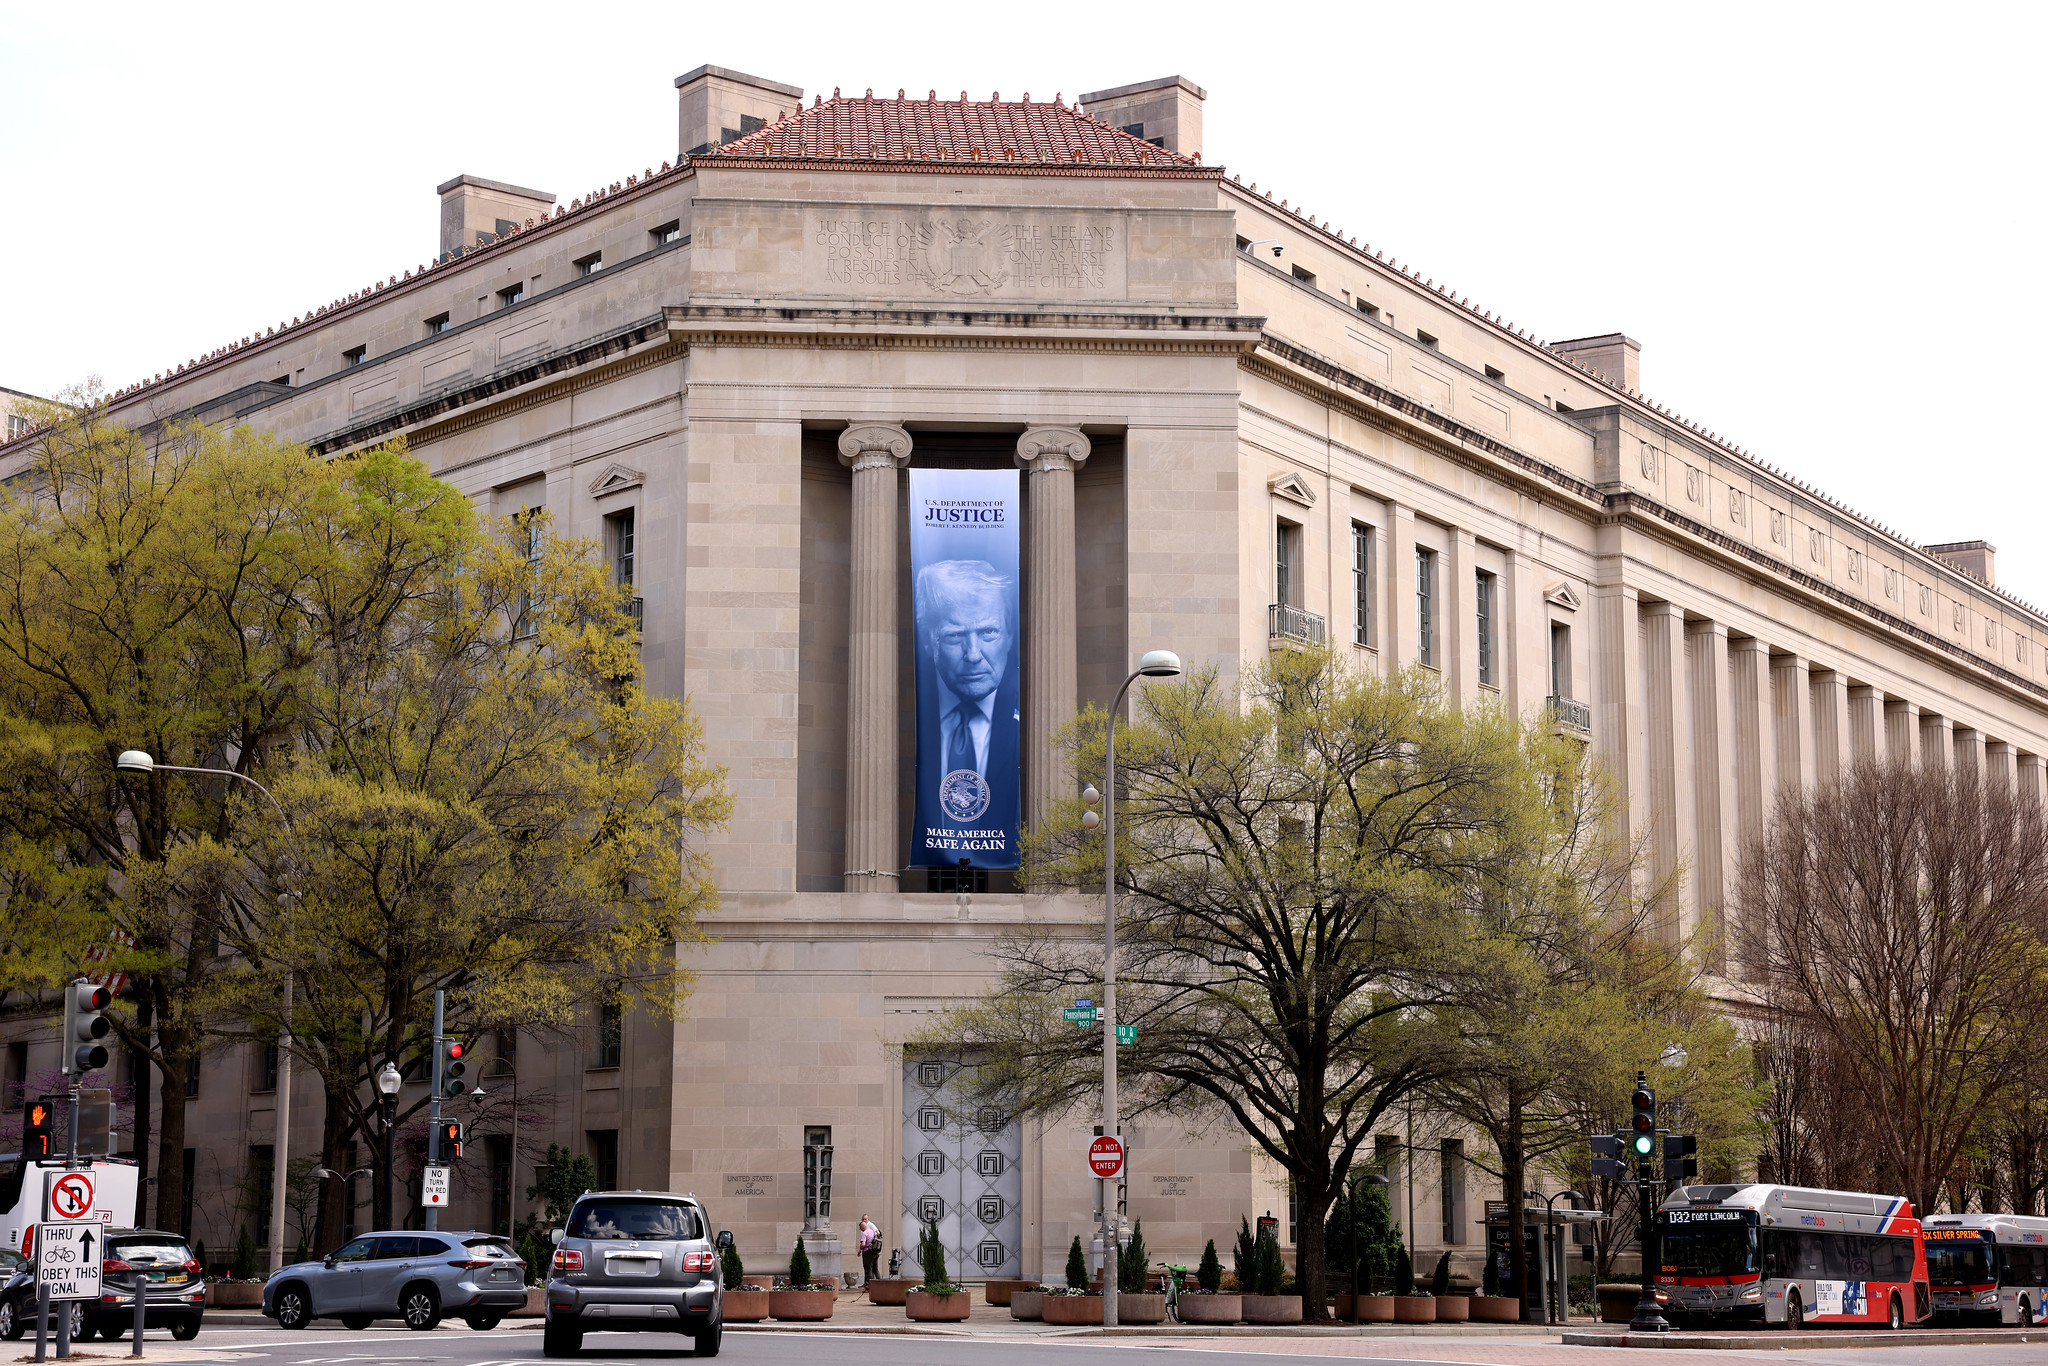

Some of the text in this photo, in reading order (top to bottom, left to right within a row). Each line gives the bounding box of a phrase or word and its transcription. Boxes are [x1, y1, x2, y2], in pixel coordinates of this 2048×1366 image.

[816, 221, 1114, 239] JUSTICE IN THE LIFE AND
[816, 233, 1113, 251] CONDUCT OF THE STATE IS
[828, 246, 1104, 264] POSSIBLE ONLY AS FIRST
[827, 259, 1105, 276] IT RESIDES IN THE HEARTS
[824, 272, 852, 284] AND
[857, 272, 901, 285] SOULS
[907, 273, 921, 286] OF
[1011, 275, 1036, 288] THE
[925, 508, 1005, 522] JUSTICE
[927, 828, 1005, 838] MAKE AMERICA
[926, 838, 1005, 850] SAFE AGAIN
[1065, 1010, 1090, 1020] Pennsylvania
[1118, 1027, 1126, 1036] 10
[40, 1135, 47, 1155] 7
[454, 1143, 459, 1156] 7
[431, 1169, 442, 1177] NO
[1669, 1212, 1740, 1223] D32 FORT LINCOLN
[1801, 1214, 1825, 1227] metrobus
[45, 1228, 74, 1240] THRU
[1922, 1230, 1979, 1240] 6X SILVER SPRING
[42, 1267, 98, 1280] OBEY THIS
[52, 1282, 79, 1294] GNAL
